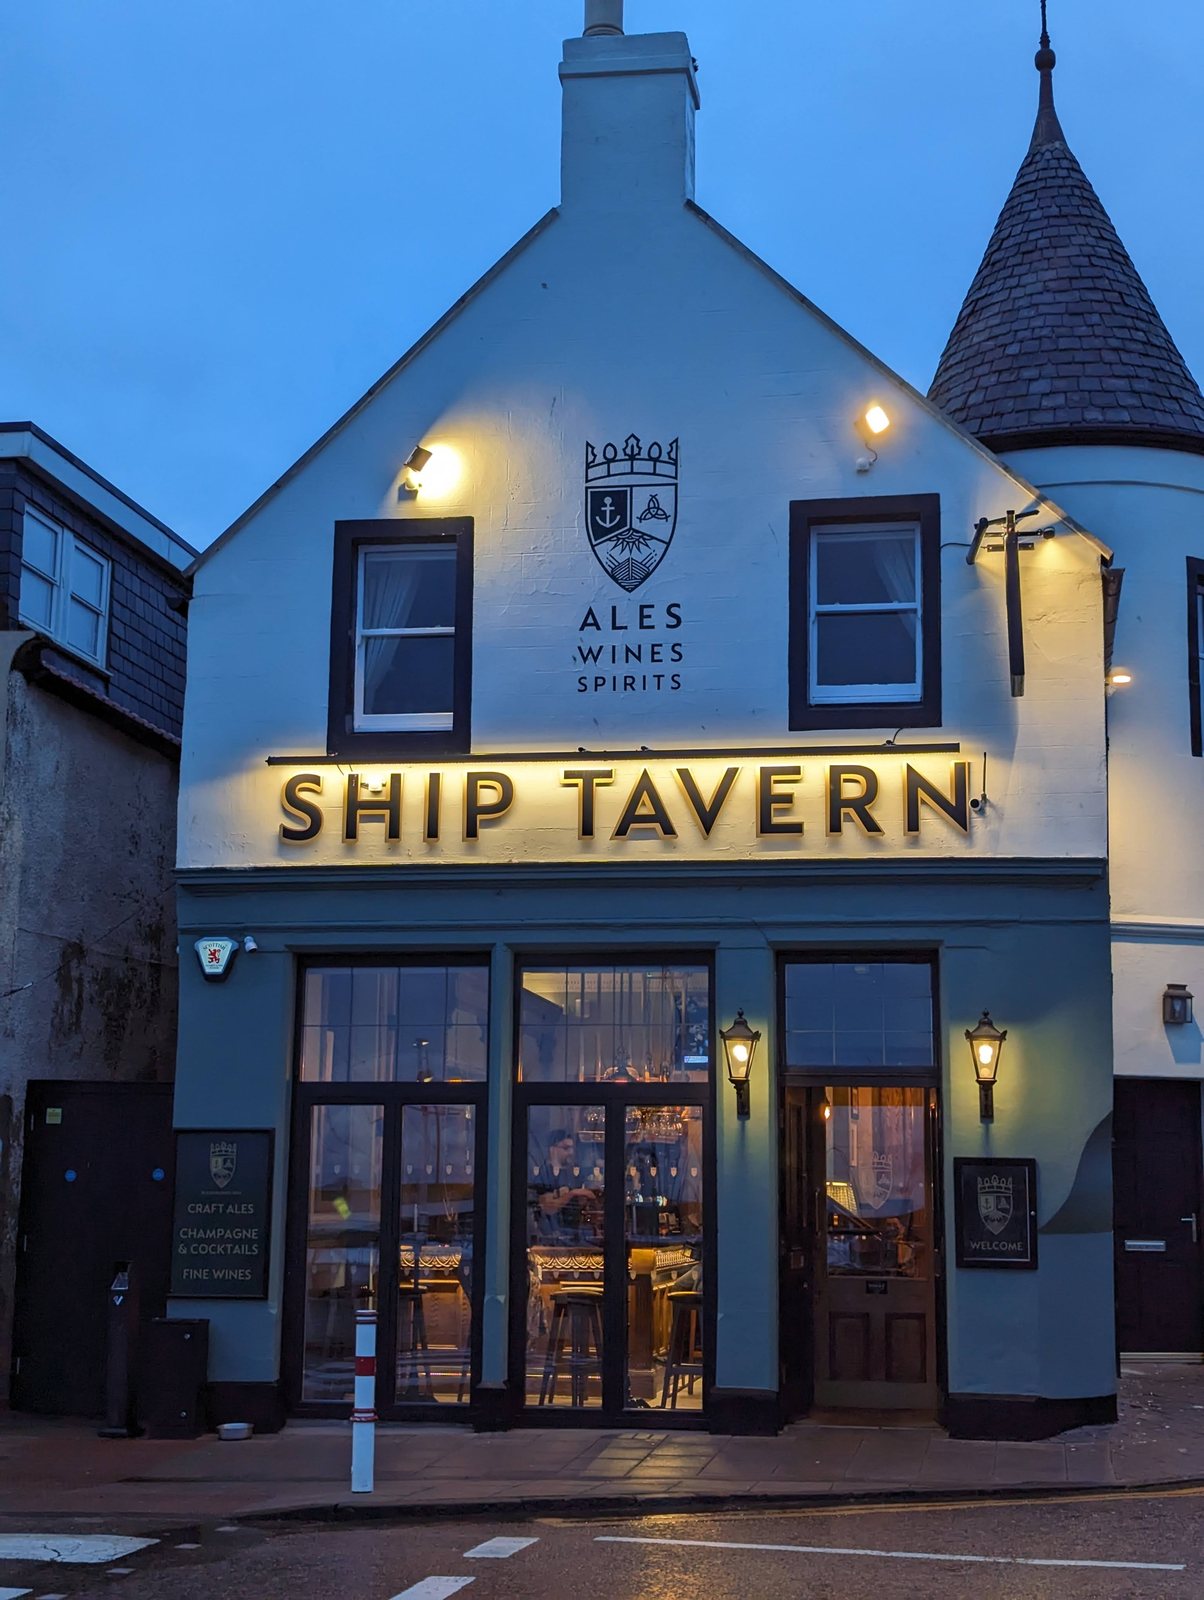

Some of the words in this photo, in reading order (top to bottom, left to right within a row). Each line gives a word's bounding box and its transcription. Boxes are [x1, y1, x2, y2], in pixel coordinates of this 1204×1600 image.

[579, 603, 682, 631] ALES
[577, 643, 683, 665] WINES
[577, 674, 681, 692] SPIRITS
[279, 770, 516, 844] SHIP
[559, 761, 969, 842] TAVERN
[187, 1203, 224, 1214] CRAFT
[226, 1203, 254, 1214] ALES
[179, 1228, 259, 1239] CHAMPAGNE
[178, 1243, 187, 1255] &
[190, 1243, 259, 1255] COCKTAILS
[970, 1241, 1023, 1251] WELCOME
[183, 1269, 209, 1280] FINE
[212, 1269, 252, 1280] WINES
